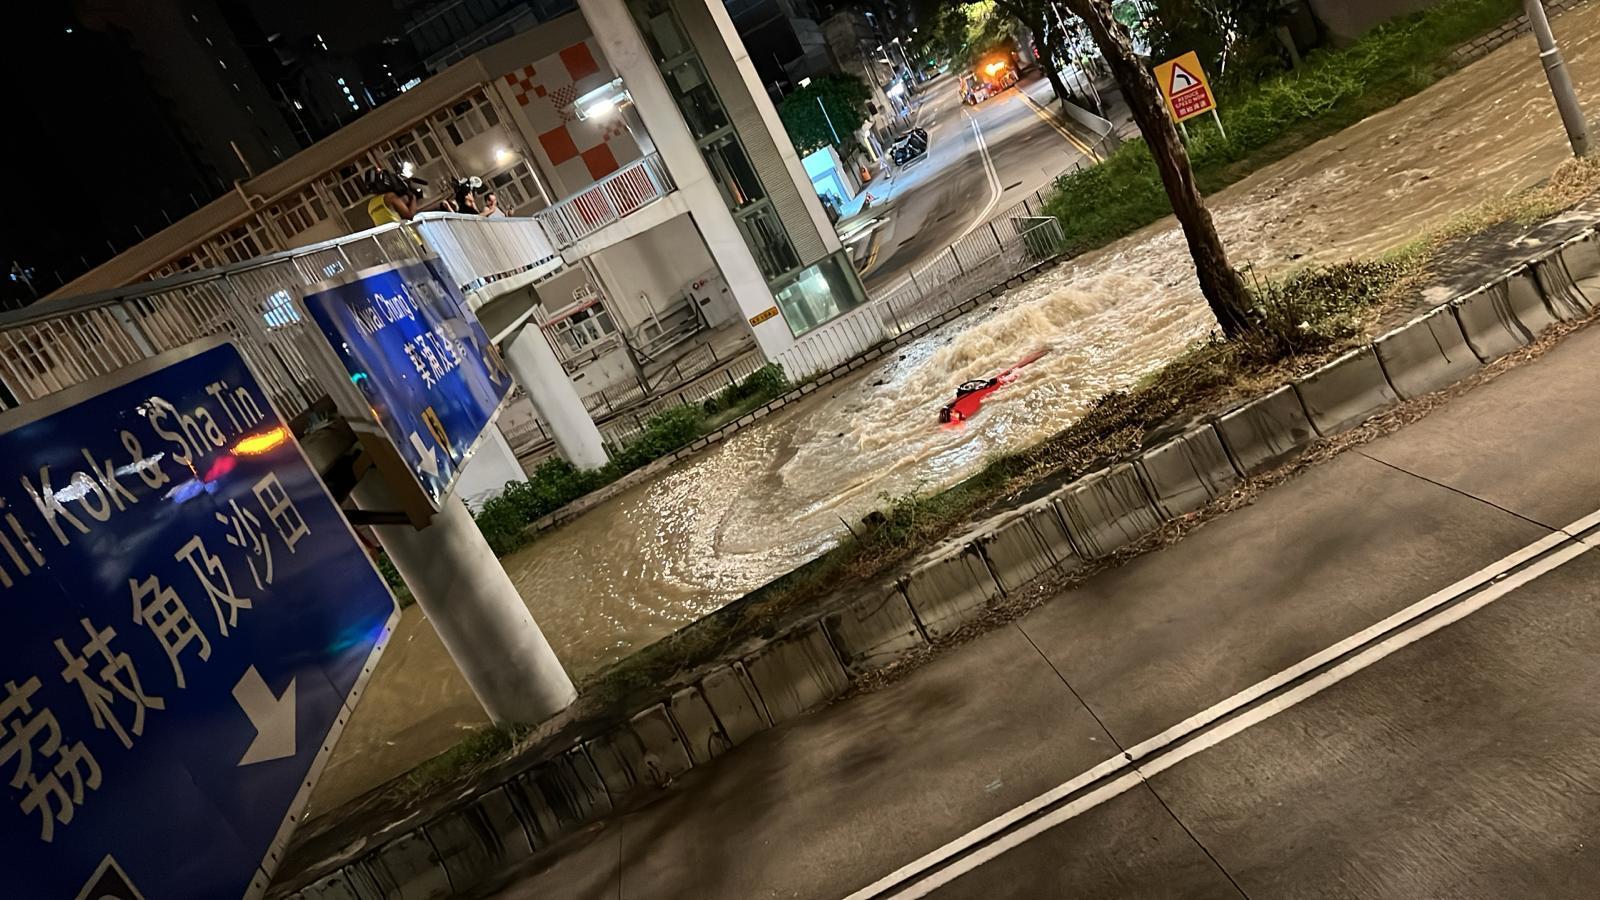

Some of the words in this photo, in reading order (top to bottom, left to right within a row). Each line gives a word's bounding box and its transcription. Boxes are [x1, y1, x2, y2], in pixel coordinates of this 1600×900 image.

[349, 298, 386, 337] Kwai
[374, 293, 415, 323] Chung
[400, 283, 418, 311] &
[19, 448, 139, 546] Kok
[120, 430, 170, 490] &
[148, 396, 227, 466] Sha
[205, 380, 264, 433] Tin
[0, 471, 311, 843] 荔枝角及沙田
